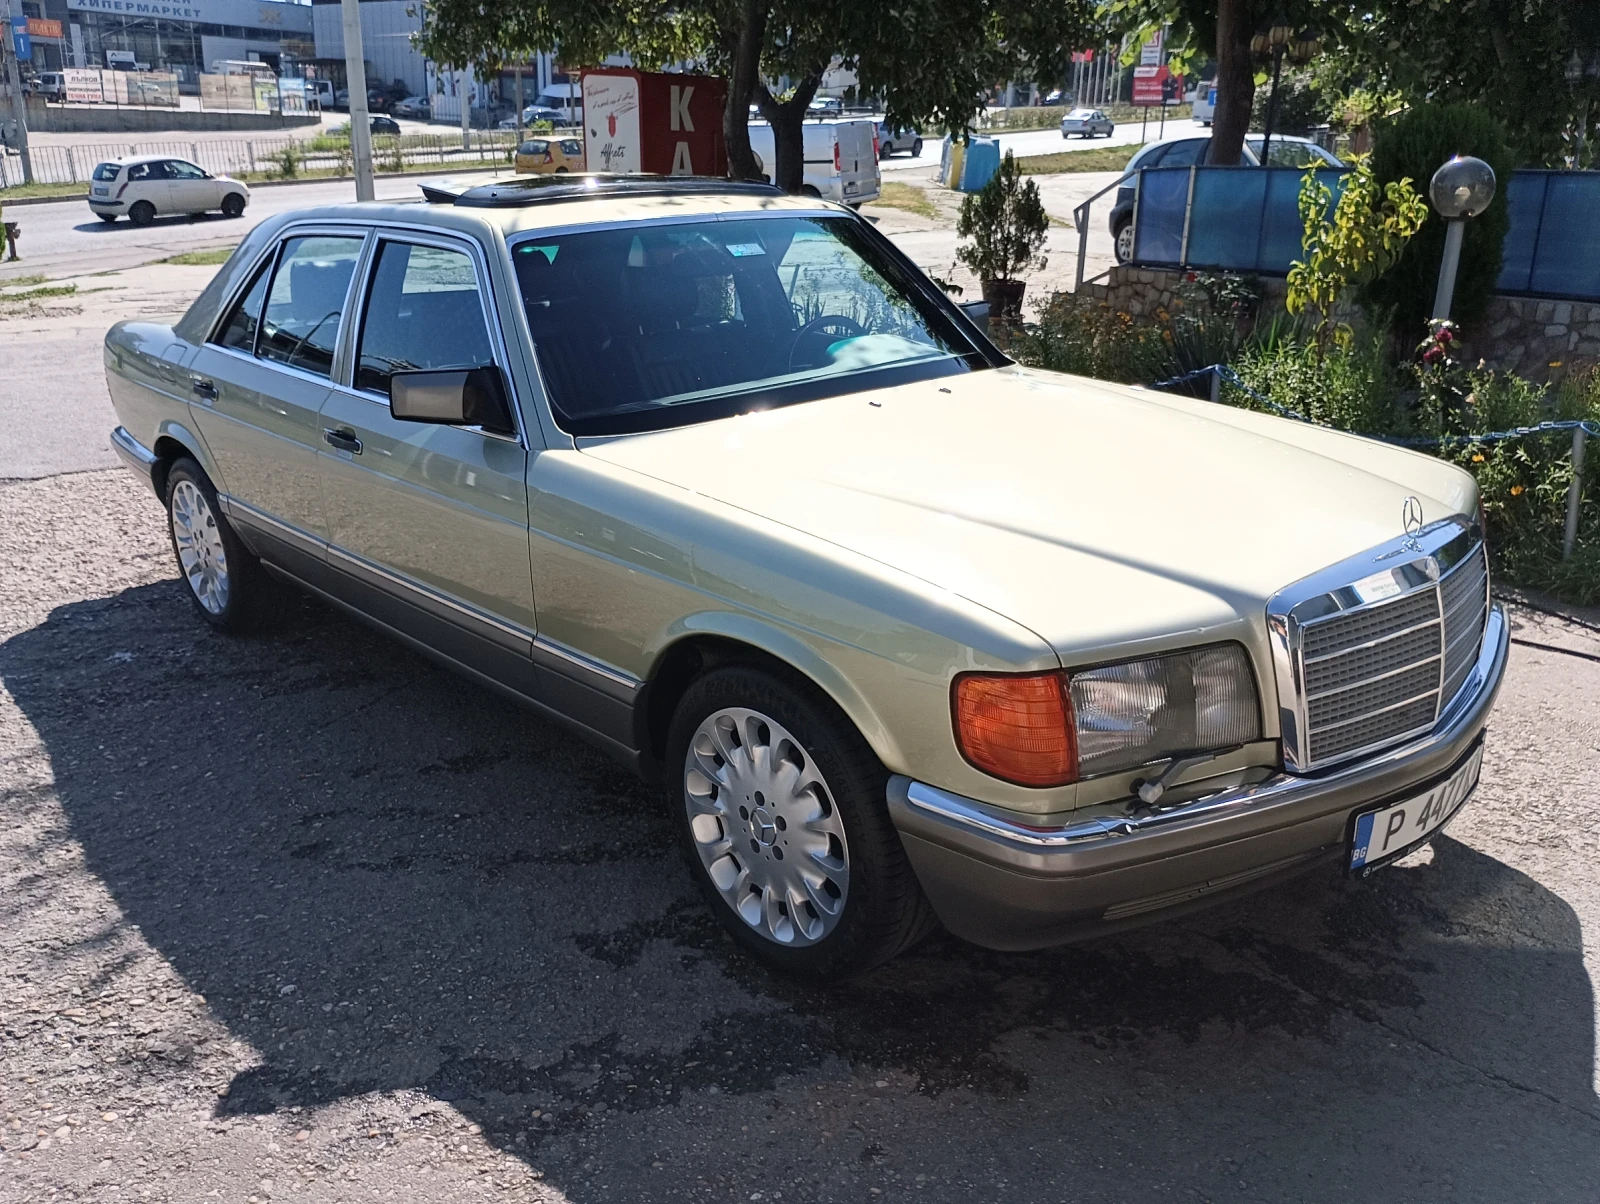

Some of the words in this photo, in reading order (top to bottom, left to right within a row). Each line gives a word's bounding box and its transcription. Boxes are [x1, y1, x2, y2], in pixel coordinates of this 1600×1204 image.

[78, 0, 201, 18] ХИПЕРМАРКЕТ
[1382, 809, 1406, 851] P
[1353, 846, 1367, 861] BG
